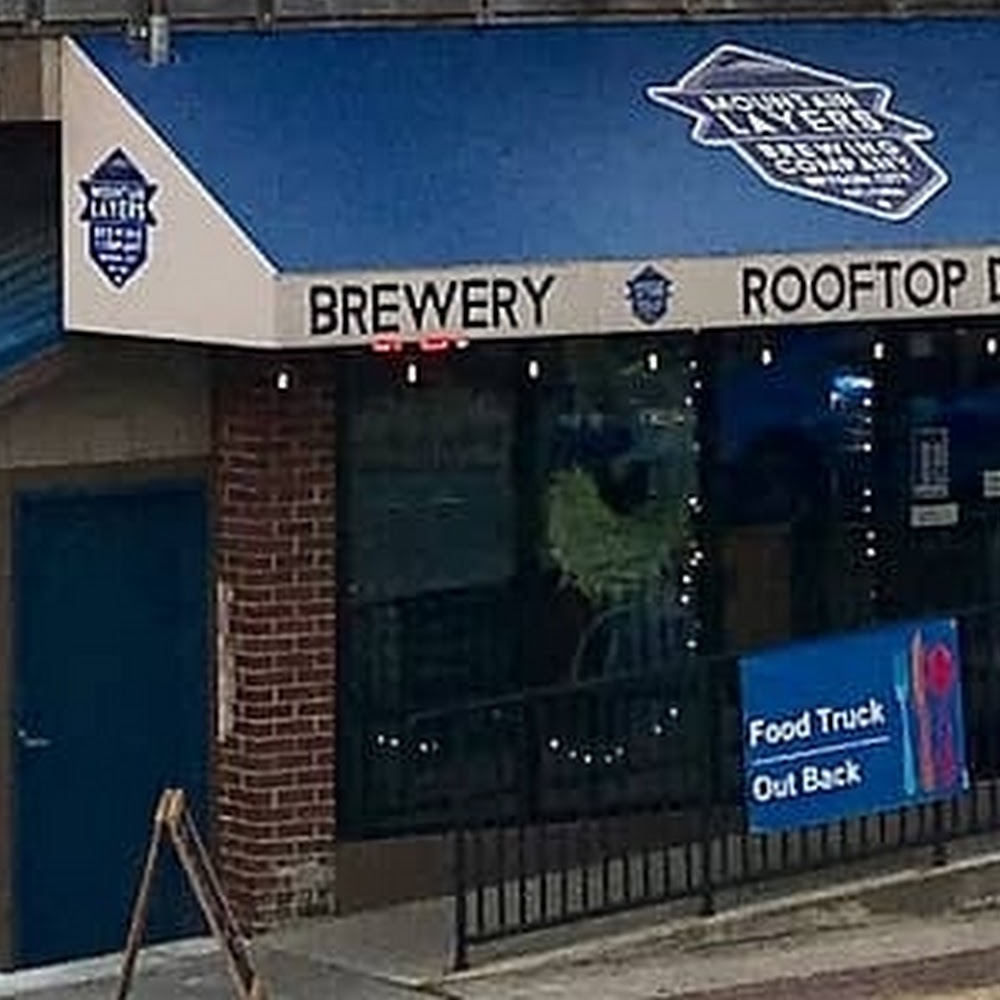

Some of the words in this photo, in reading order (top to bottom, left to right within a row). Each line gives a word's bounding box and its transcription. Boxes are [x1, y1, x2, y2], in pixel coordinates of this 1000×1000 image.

[716, 110, 884, 135] LAYERS
[310, 275, 555, 335] BREWERY
[743, 259, 967, 315] ROOFTOP
[749, 711, 811, 748] Food
[816, 698, 885, 734] Truck
[752, 772, 798, 801] Out
[802, 760, 861, 793] Back
